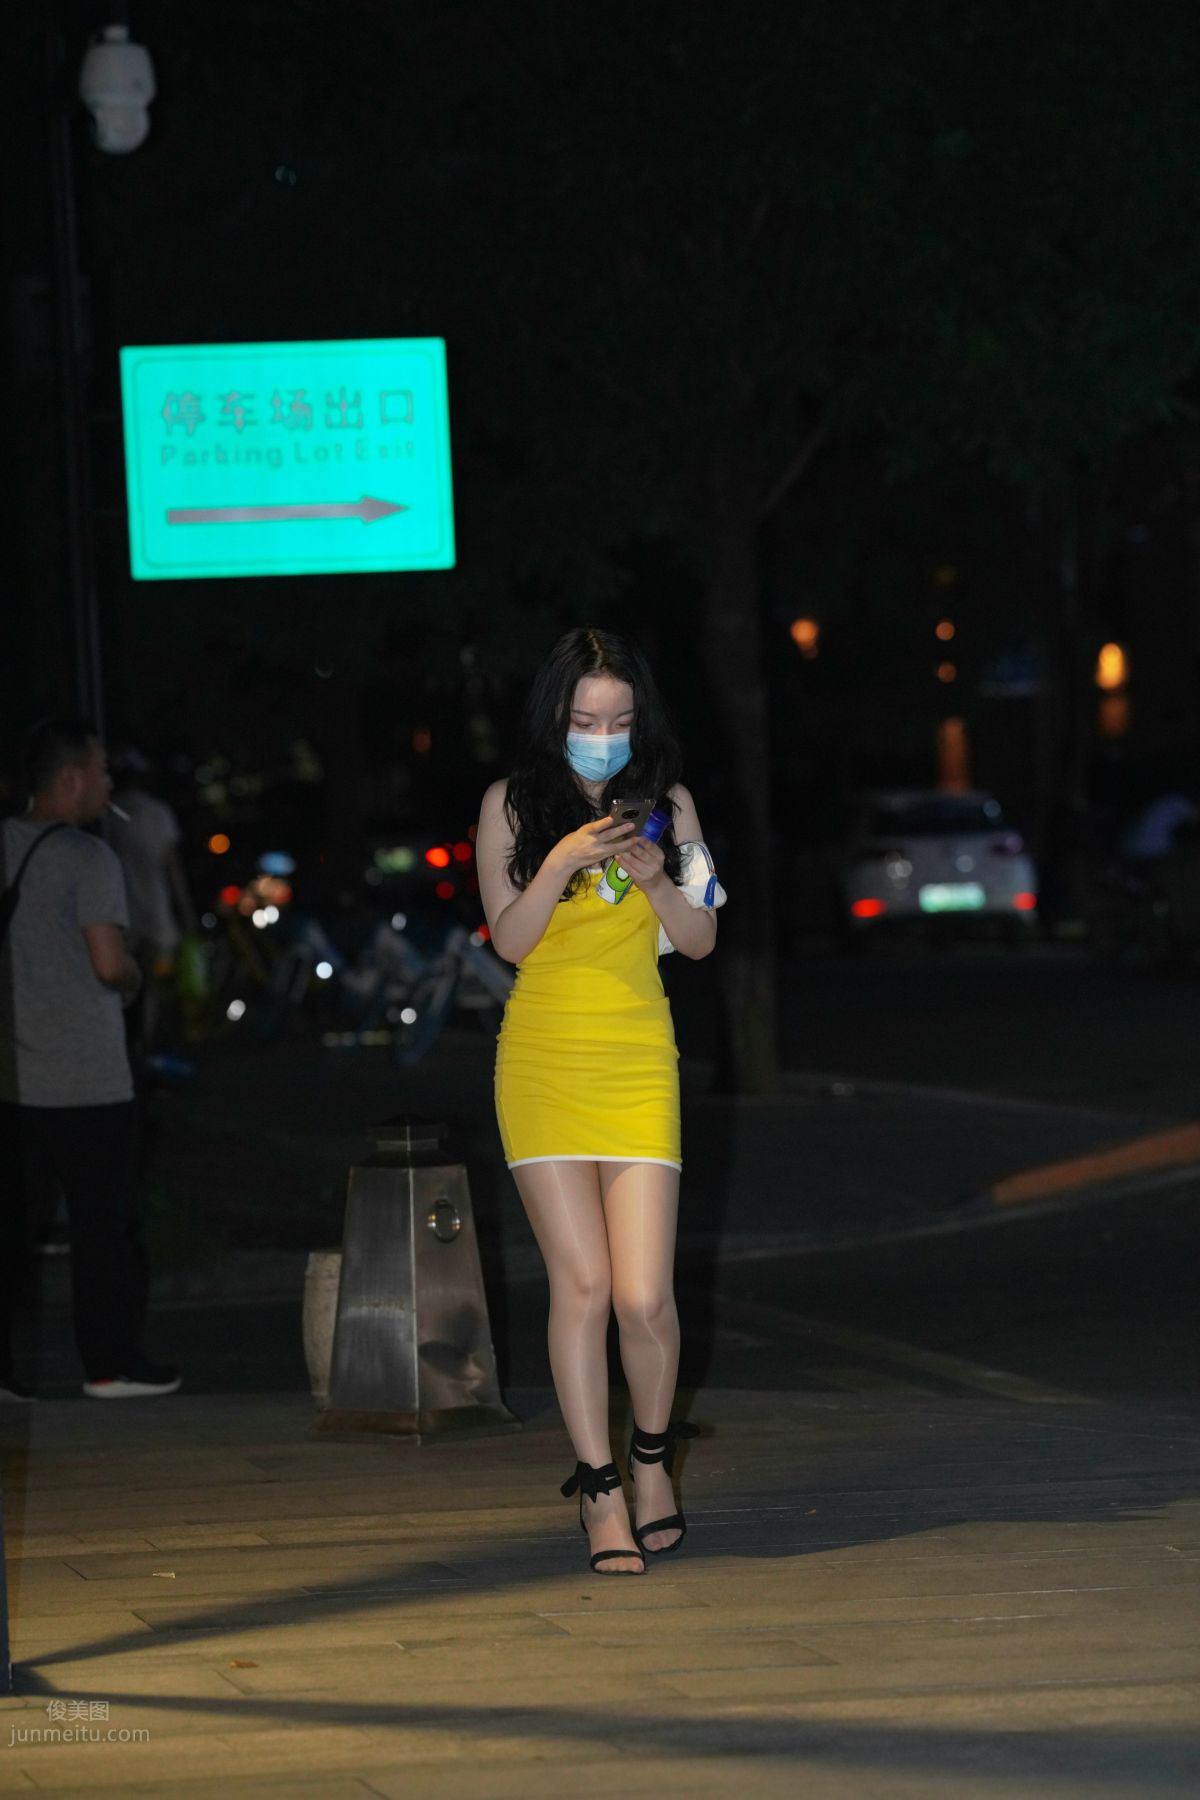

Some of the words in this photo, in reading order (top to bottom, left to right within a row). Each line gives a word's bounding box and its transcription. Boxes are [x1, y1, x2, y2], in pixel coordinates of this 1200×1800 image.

[161, 386, 414, 438] 停车场出口
[160, 443, 283, 469] Parking
[293, 440, 344, 464] Lot
